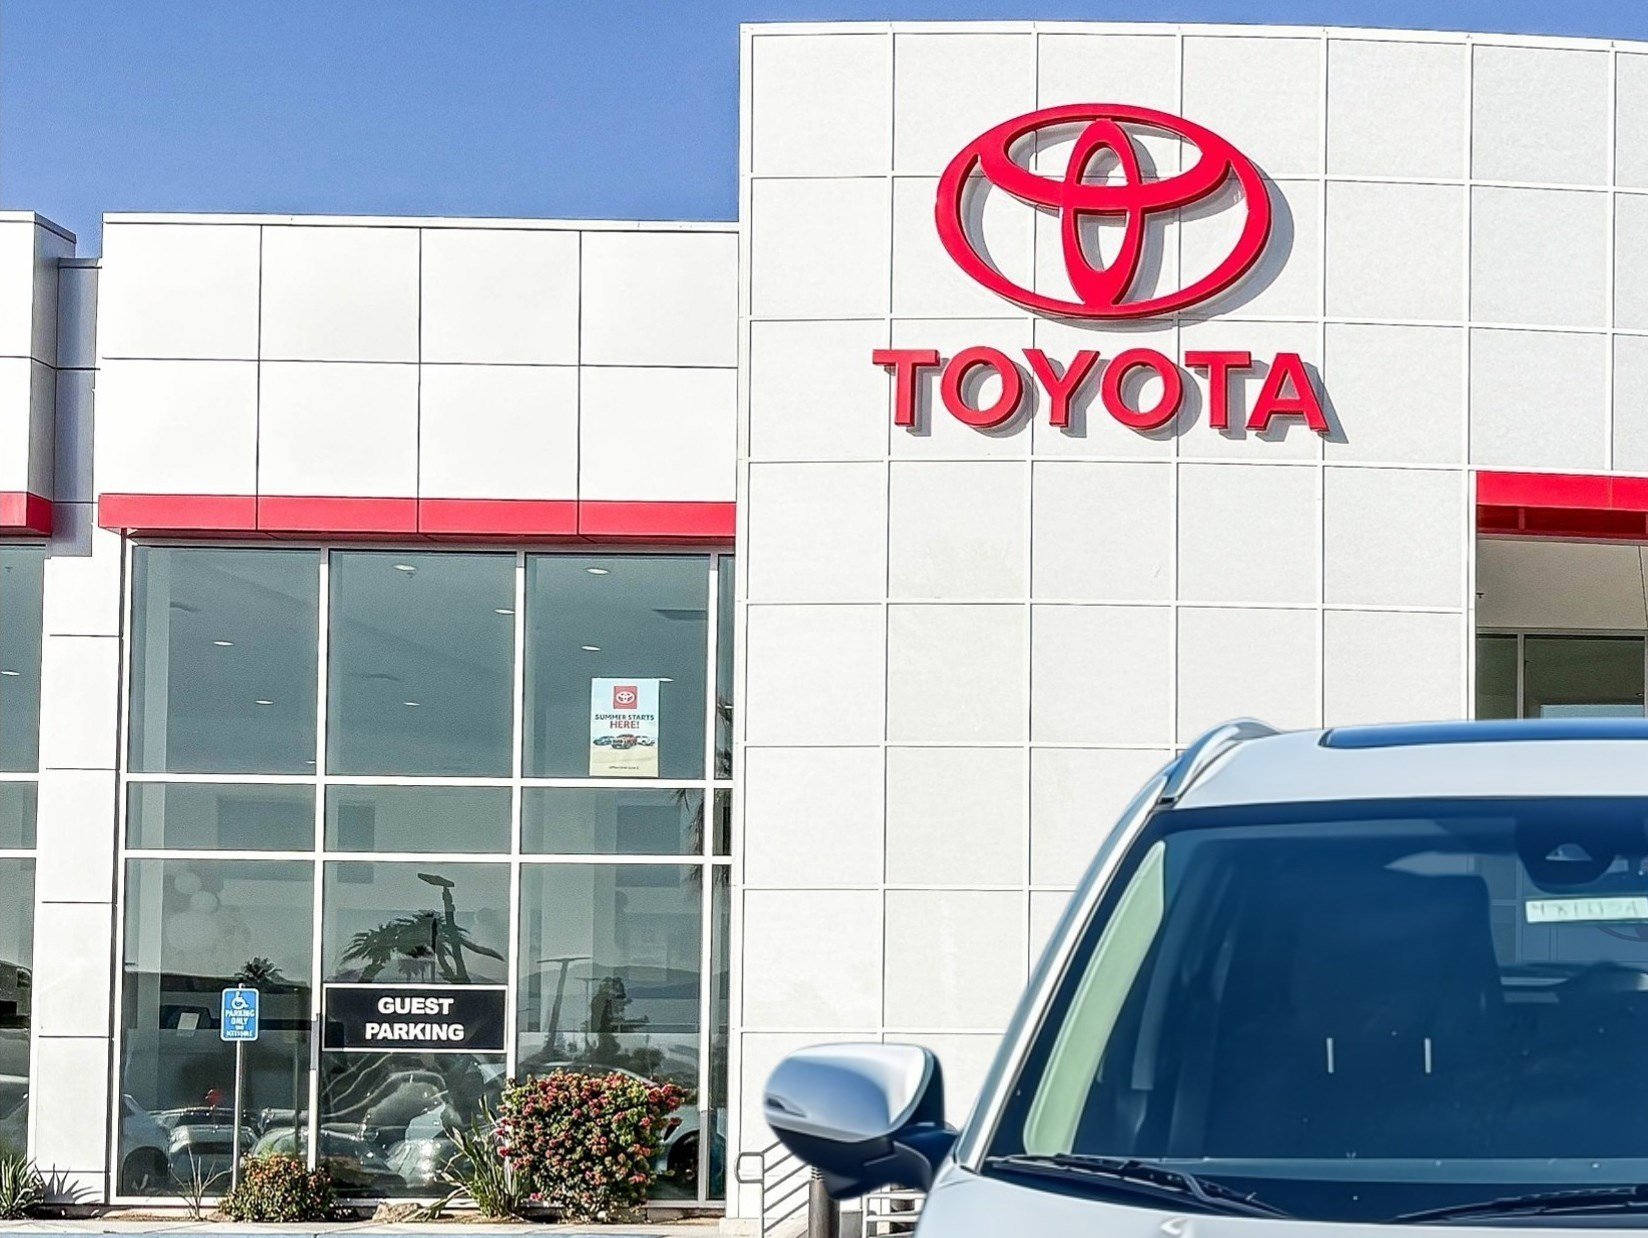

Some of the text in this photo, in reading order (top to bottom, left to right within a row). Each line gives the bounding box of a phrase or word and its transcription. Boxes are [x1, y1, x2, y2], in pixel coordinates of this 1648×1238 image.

[873, 346, 1329, 432] TOYOTA
[609, 721, 640, 729] HERE!
[225, 1009, 255, 1017] PARKING
[377, 996, 454, 1015] GUEST
[365, 1022, 464, 1041] PARKING
